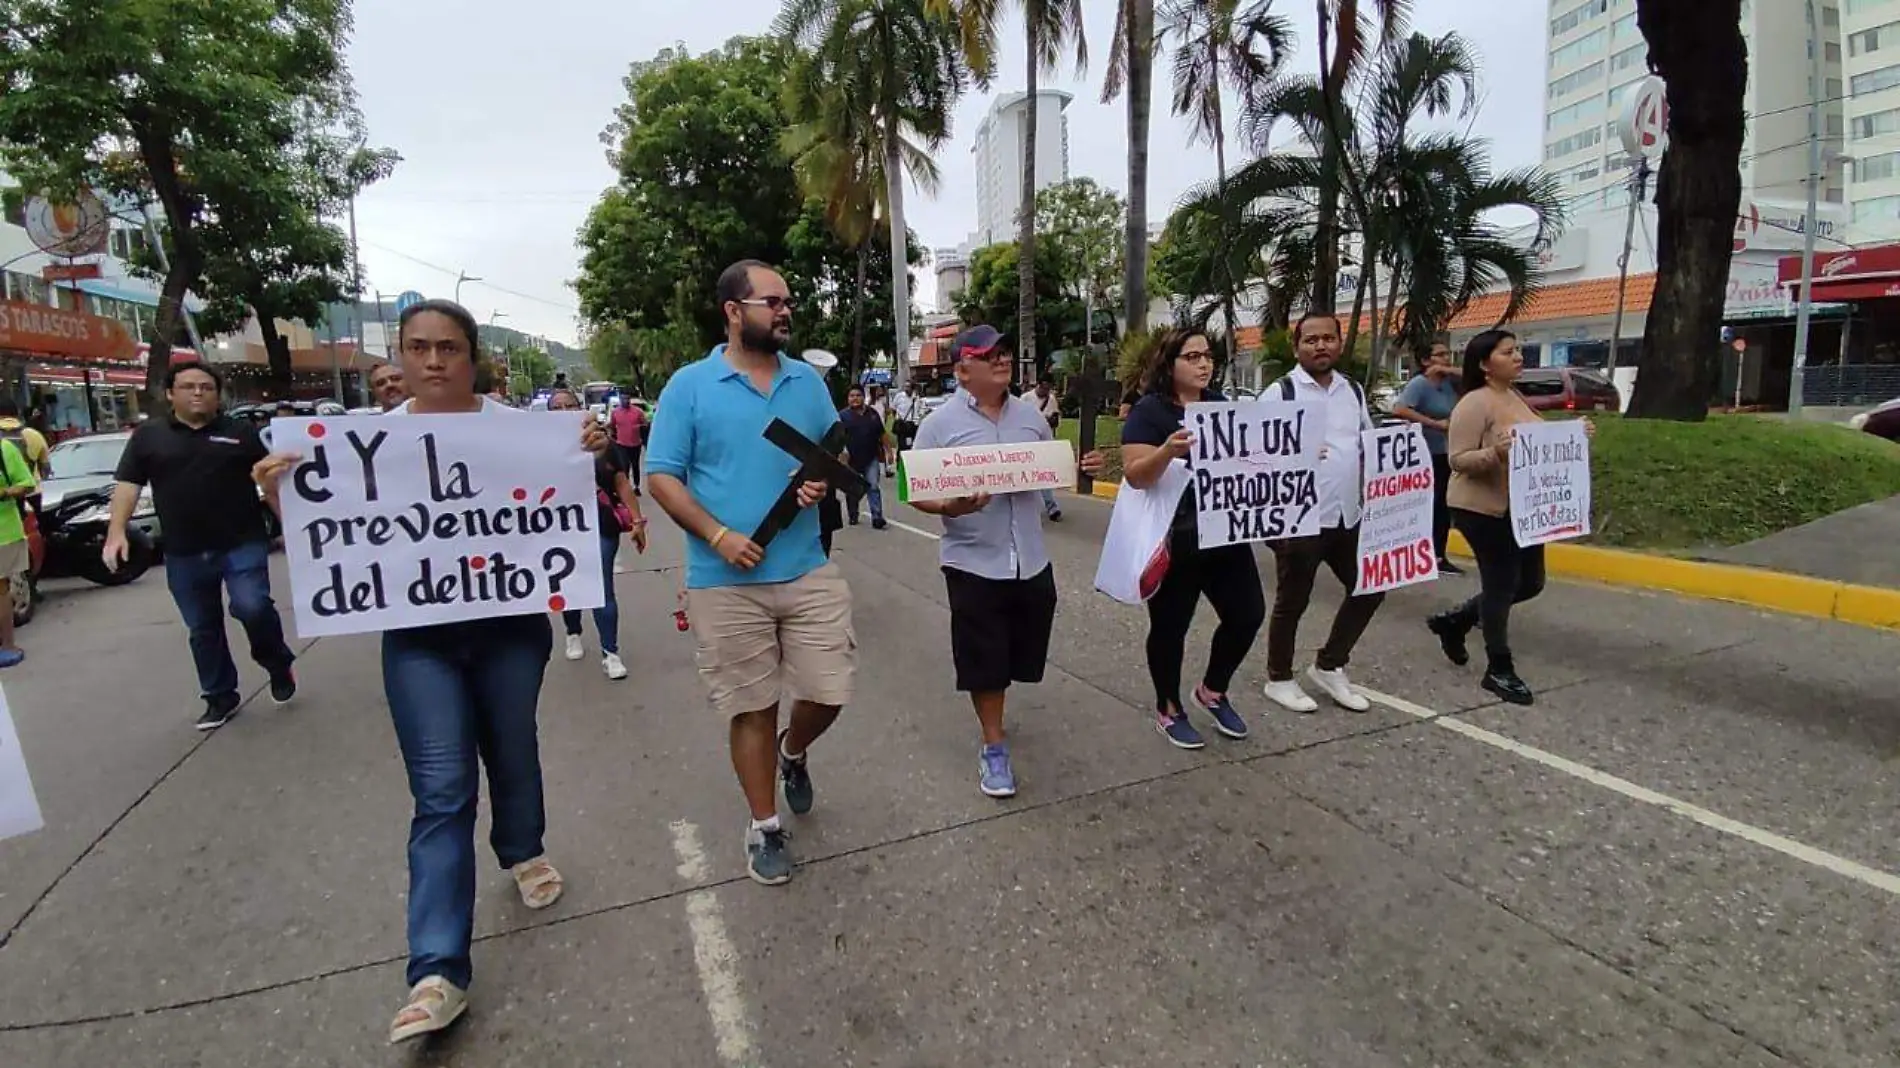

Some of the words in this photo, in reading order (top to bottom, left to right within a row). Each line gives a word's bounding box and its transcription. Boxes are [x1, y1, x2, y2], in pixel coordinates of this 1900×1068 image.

[1262, 408, 1305, 456] UN
[1377, 431, 1420, 474] FGE
[418, 432, 483, 502] la
[1196, 468, 1319, 512] PERIODISTA
[1366, 467, 1431, 501] EXIGIMOS
[302, 486, 591, 560] prevención
[311, 561, 391, 617] del
[407, 546, 576, 614] delito?
[1362, 539, 1434, 590] MATUS
